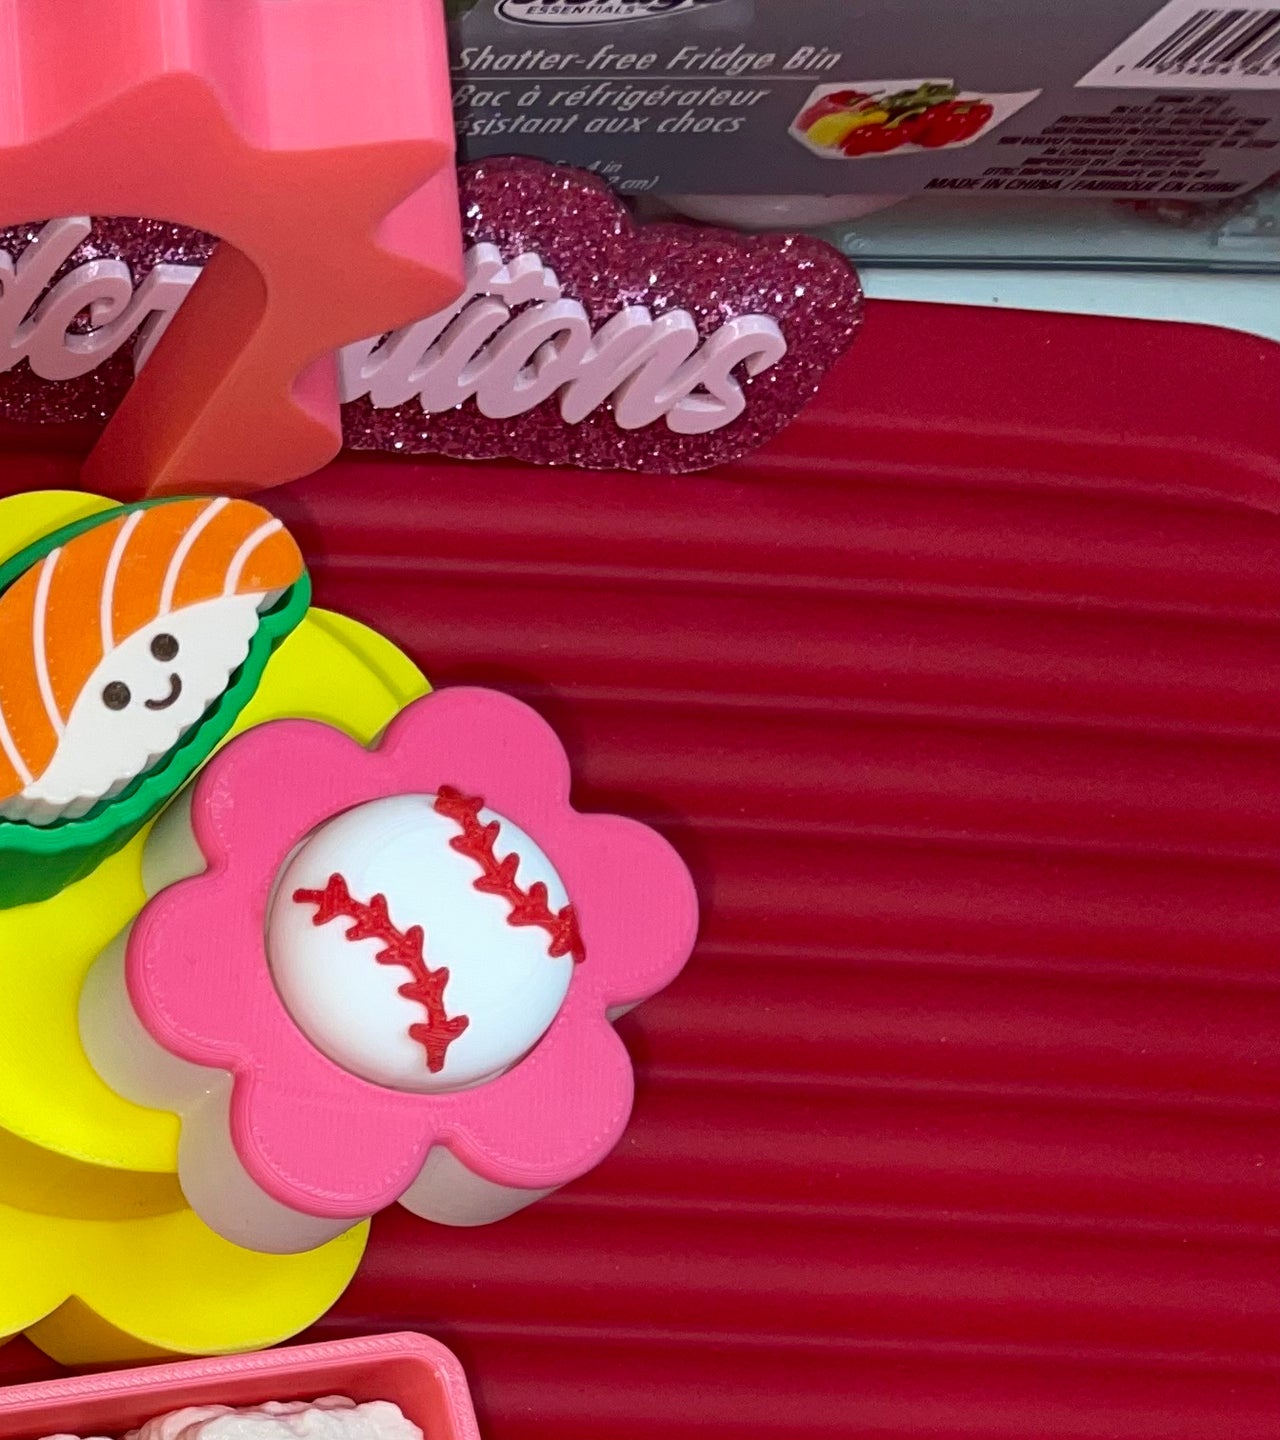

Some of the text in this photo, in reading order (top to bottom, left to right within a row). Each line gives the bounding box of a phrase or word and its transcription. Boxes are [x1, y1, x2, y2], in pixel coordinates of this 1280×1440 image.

[525, 5, 636, 15] ESSENTIALS
[459, 42, 842, 76] Shatter-free Fridge Bin
[453, 82, 770, 112] Bac à réfrigérateur
[584, 117, 649, 134] aux
[656, 109, 747, 134] chocs
